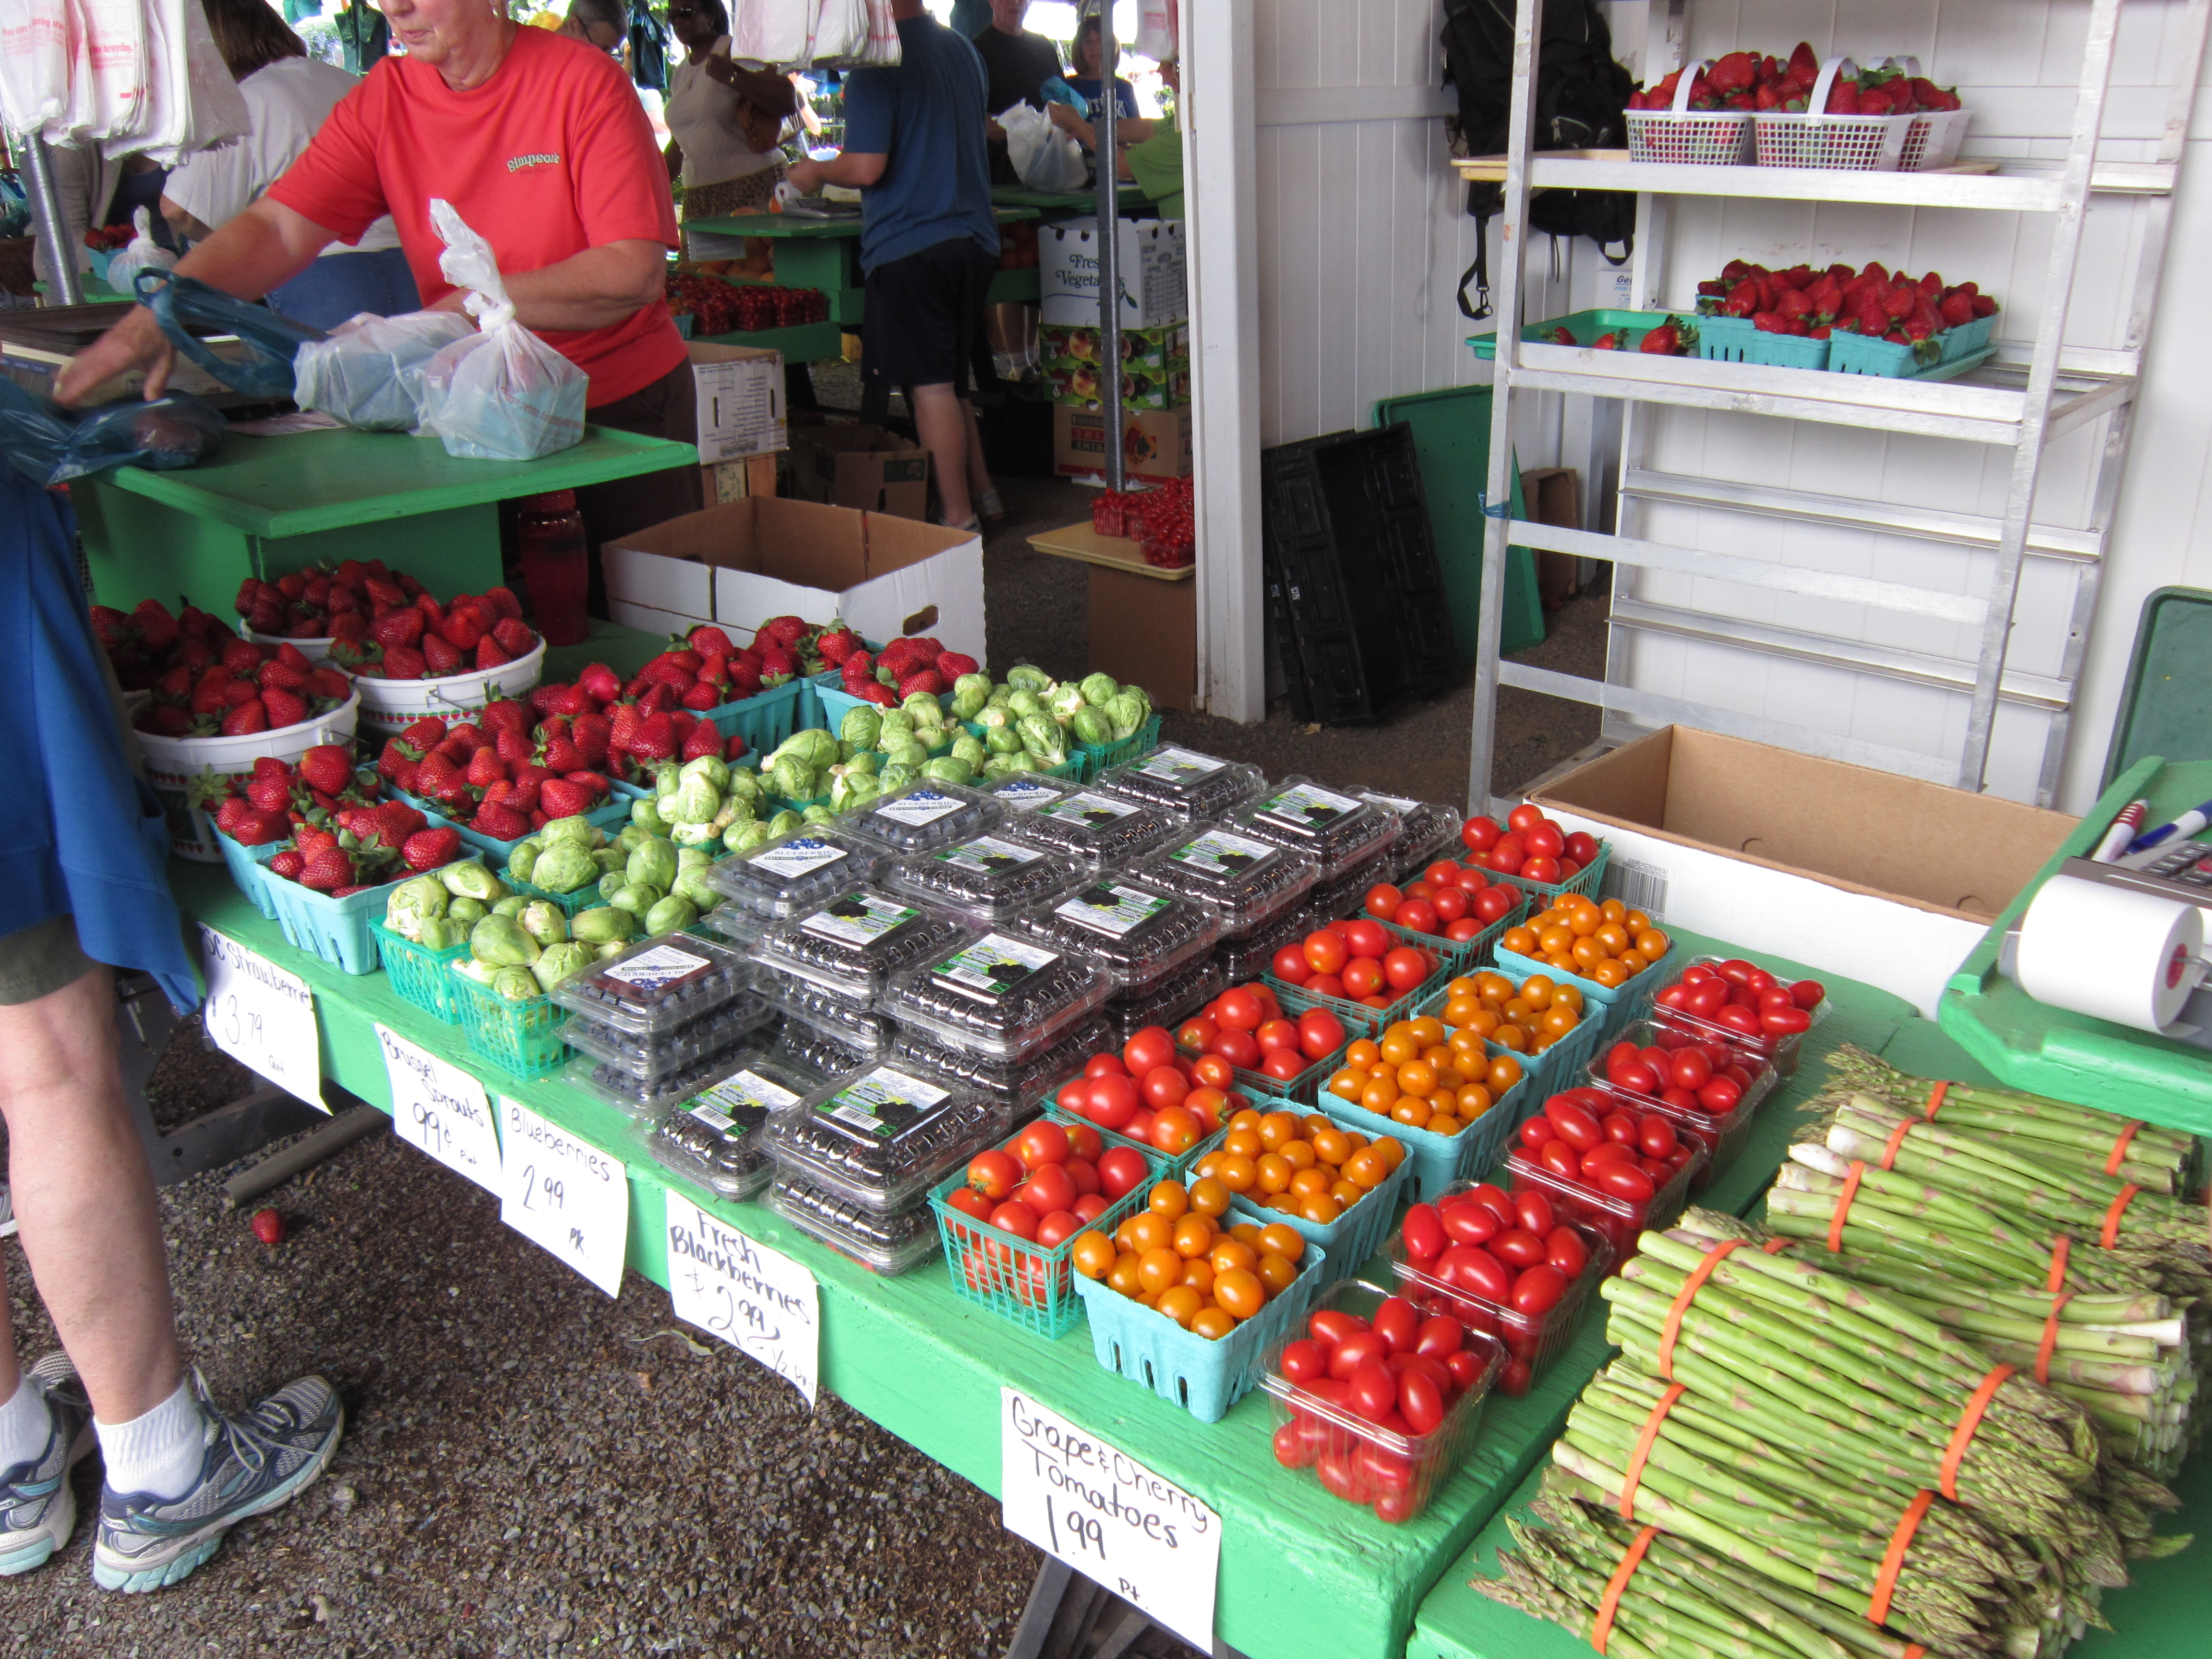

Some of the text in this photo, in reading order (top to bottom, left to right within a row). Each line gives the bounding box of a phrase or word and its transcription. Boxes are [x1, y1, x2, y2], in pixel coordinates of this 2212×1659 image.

[1056, 270, 1125, 289] Vegetas
[1070, 254, 1099, 268] Fres
[1076, 441, 1105, 452] RIME
[226, 994, 263, 1045] 3.79
[381, 1031, 438, 1084] Brussel
[421, 1078, 484, 1128] Sprouts
[879, 1072, 938, 1098] Valley View
[511, 1107, 610, 1182] Blueberries
[697, 1209, 762, 1274] Fresh
[670, 1225, 811, 1325] Blackberries
[1012, 1396, 1207, 1534] Grape & Cherry
[1021, 1438, 1178, 1549] Tomatoes
[1046, 1494, 1106, 1561] 1.99
